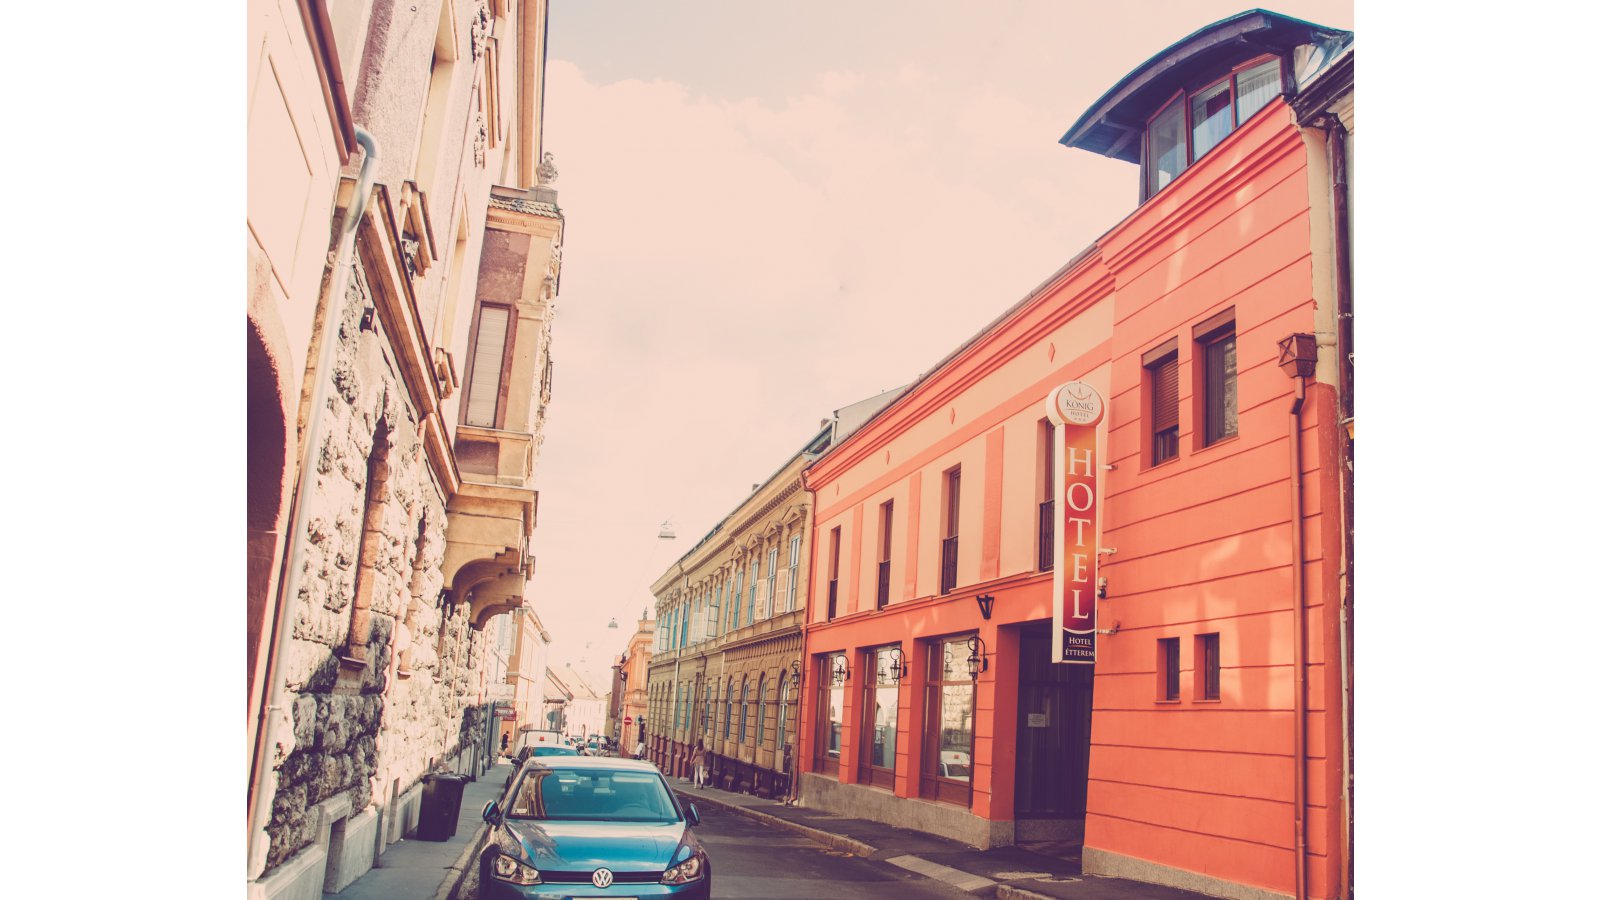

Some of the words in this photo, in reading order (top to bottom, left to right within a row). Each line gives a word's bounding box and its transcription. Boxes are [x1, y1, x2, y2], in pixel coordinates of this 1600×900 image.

[1067, 447, 1094, 619] HOTEL
[1069, 637, 1092, 645] HOTEL
[1065, 648, 1095, 657] ÉTTEREM
[593, 868, 613, 888] VW
